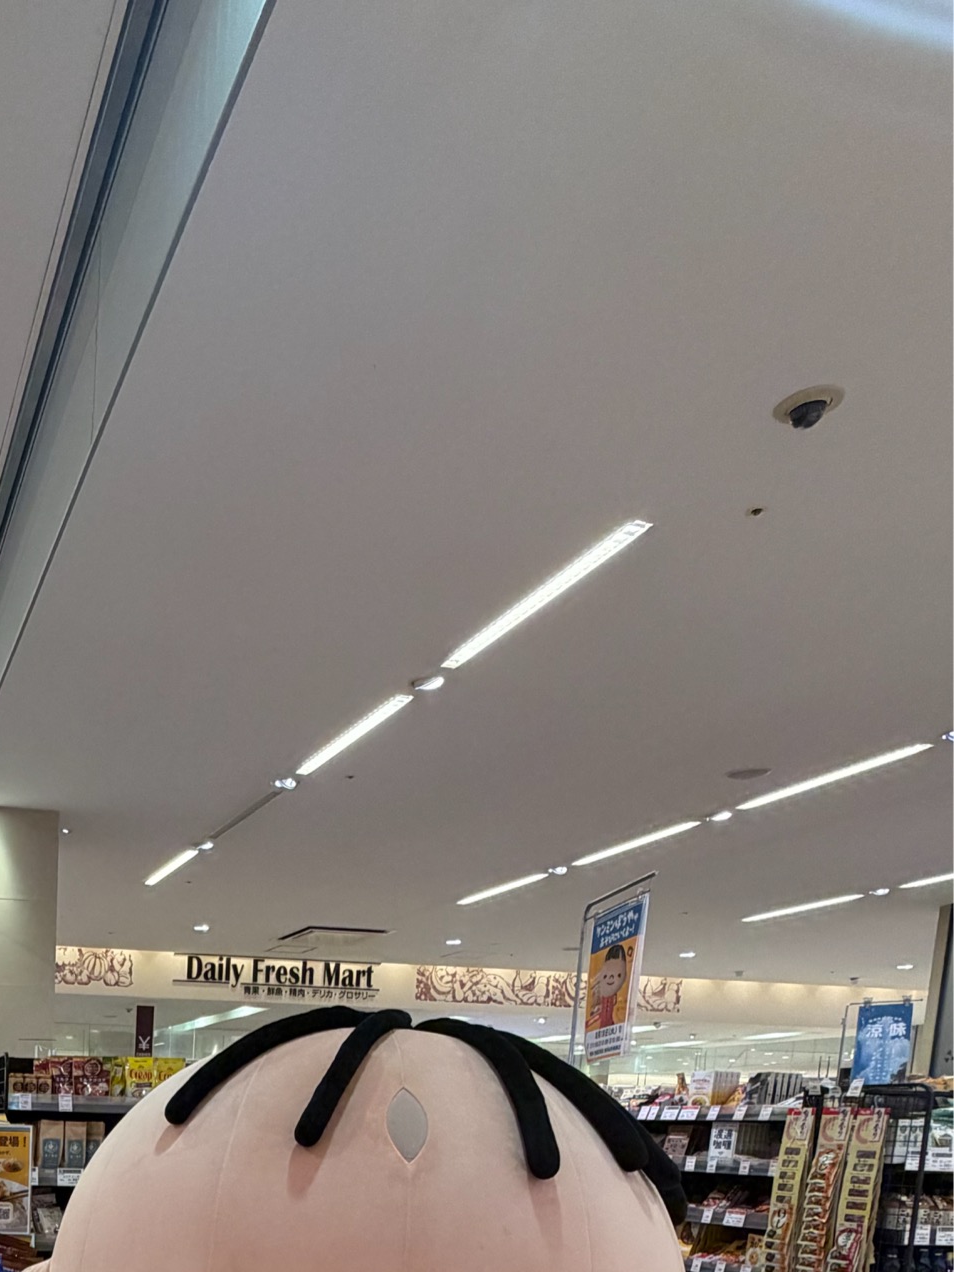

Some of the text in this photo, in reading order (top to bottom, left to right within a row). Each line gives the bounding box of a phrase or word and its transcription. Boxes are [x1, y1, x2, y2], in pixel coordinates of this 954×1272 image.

[187, 956, 373, 987] Daily Fresh Mart
